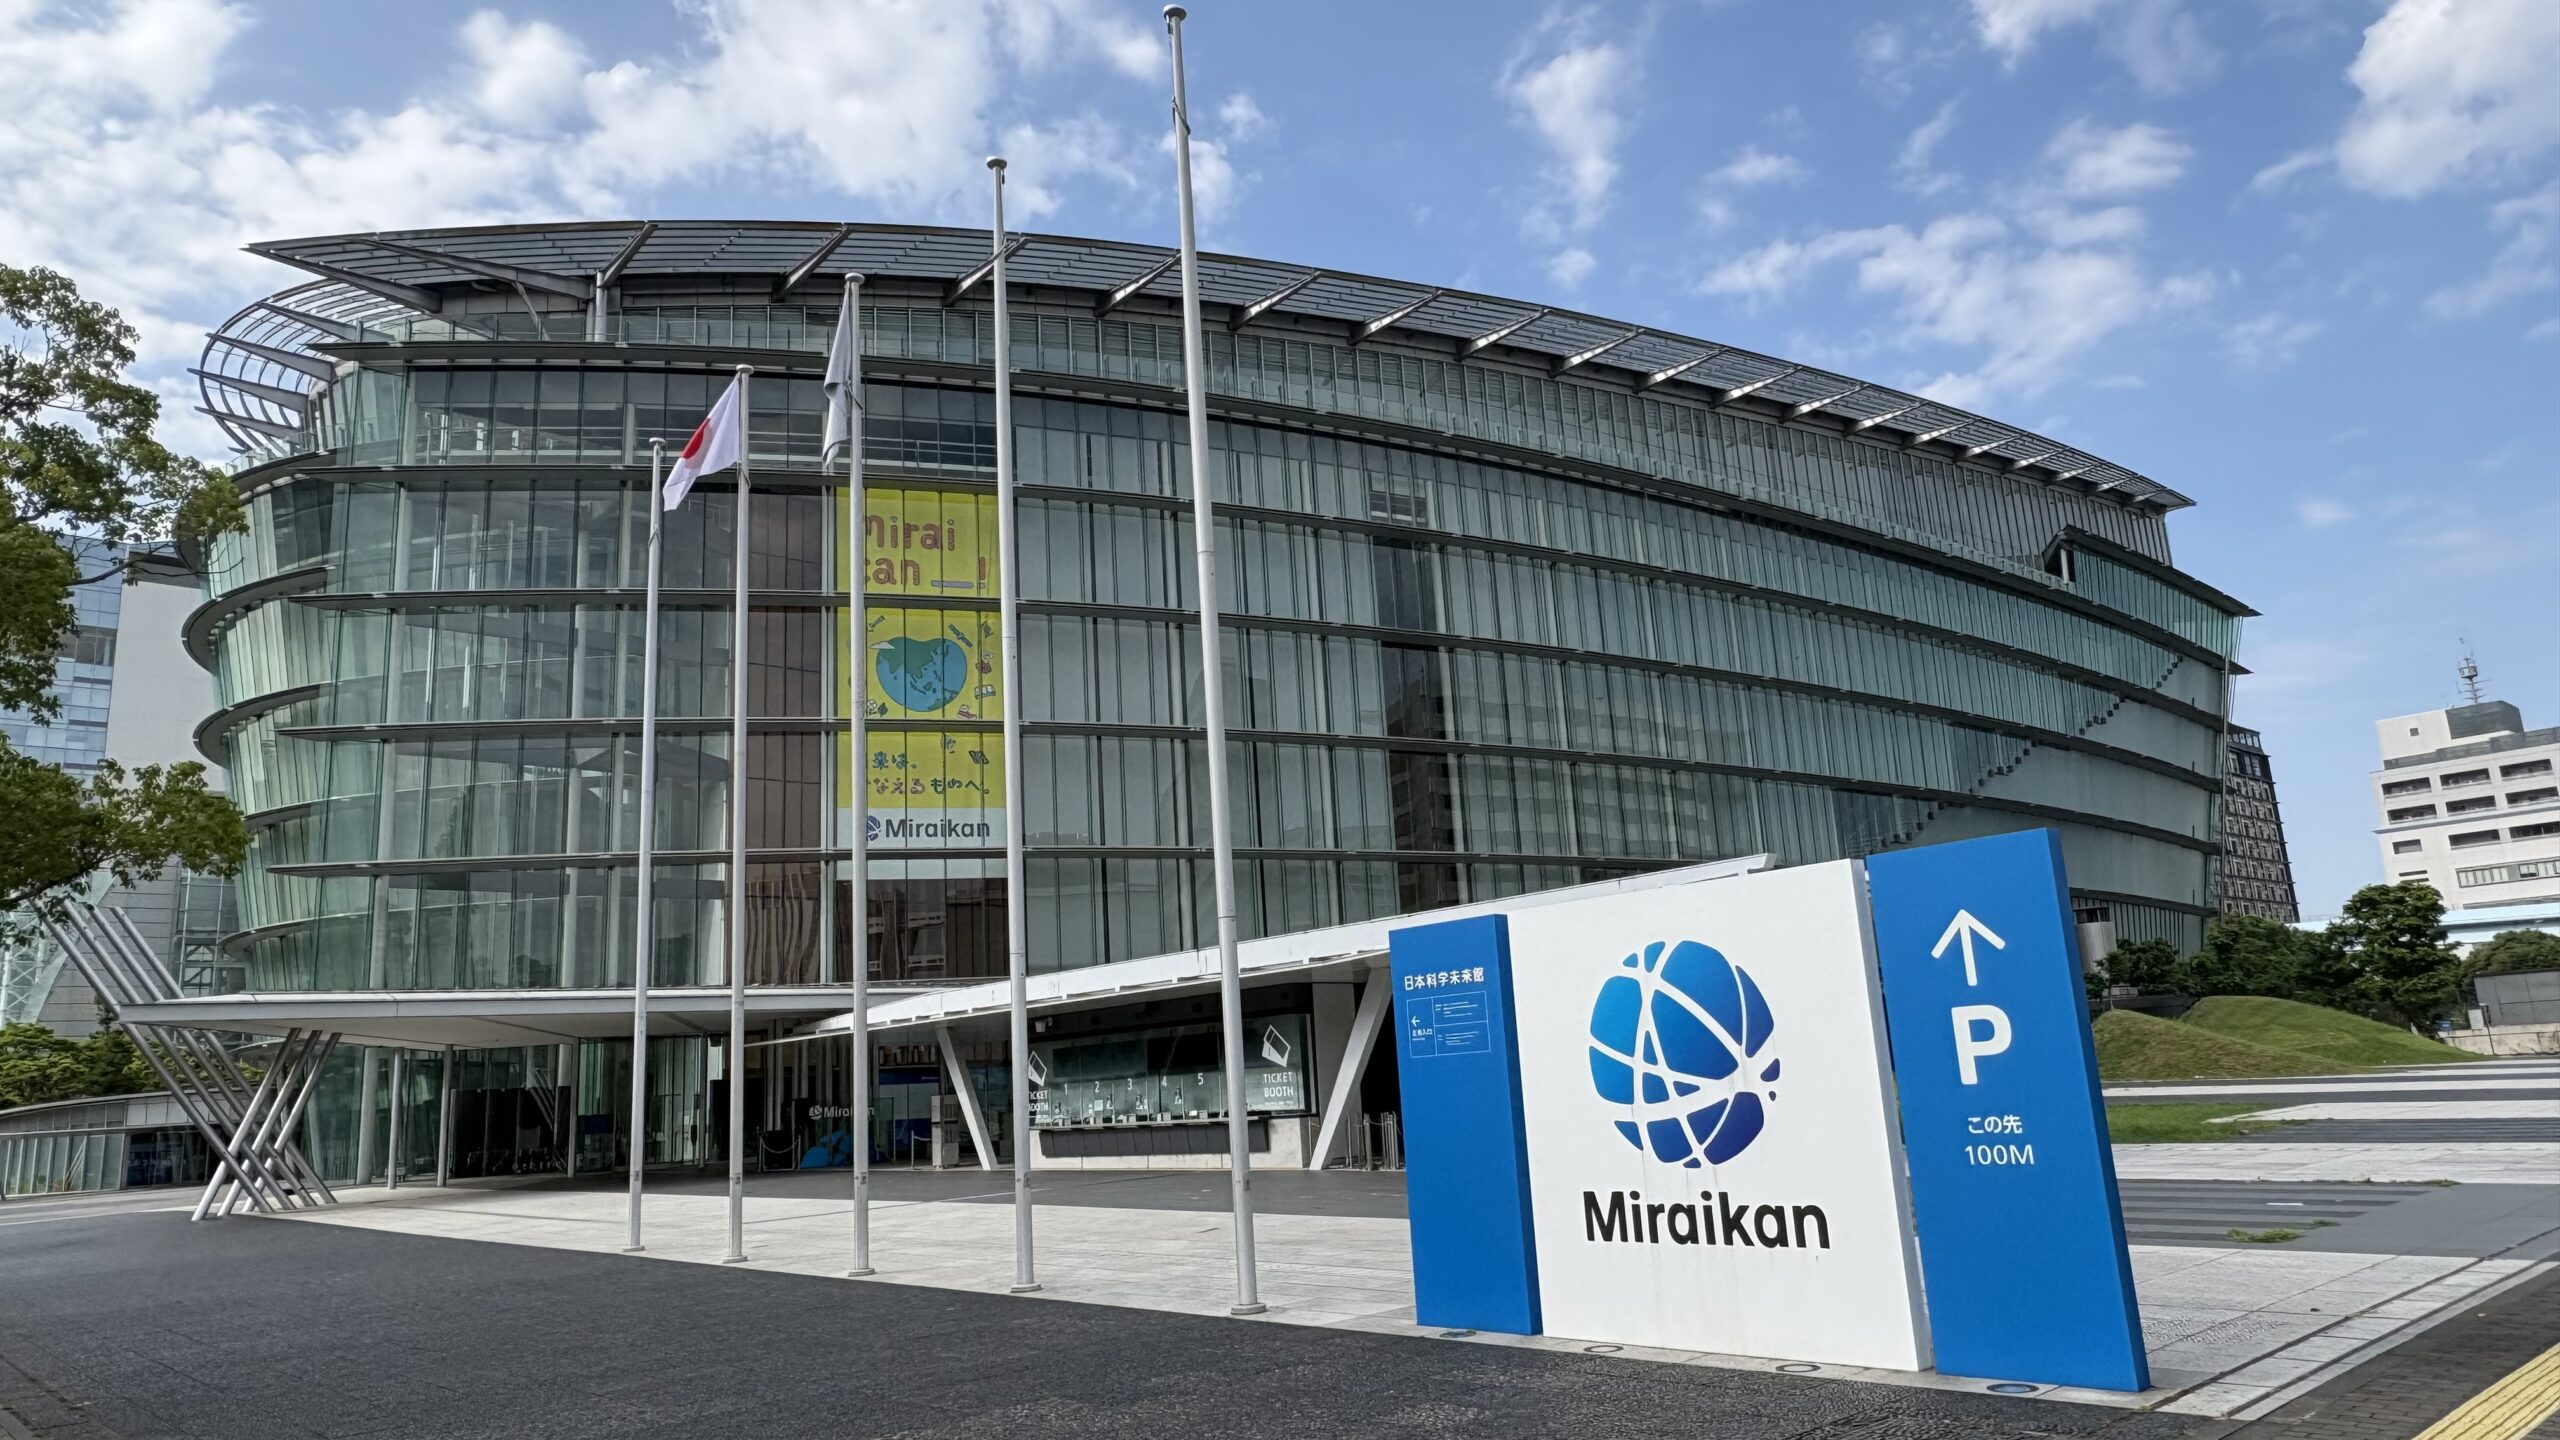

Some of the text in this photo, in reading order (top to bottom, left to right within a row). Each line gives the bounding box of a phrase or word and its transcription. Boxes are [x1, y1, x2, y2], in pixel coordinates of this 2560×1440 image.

[885, 819, 990, 838] Miraikan
[1404, 967, 1484, 991] 日本科学未来館
[1951, 1004, 2012, 1085] P
[1127, 1078, 1133, 1091] 3
[1161, 1075, 1168, 1088] 4
[1197, 1072, 1204, 1085] 5
[1263, 1072, 1293, 1084] TICKET
[1094, 1081, 1100, 1093] 2
[1264, 1085, 1294, 1098] BOOTH
[823, 1105, 875, 1118] Mirain
[1967, 1114, 2023, 1134] この先
[1964, 1144, 2035, 1166] 100M
[1583, 1190, 1831, 1250] Miraikan
